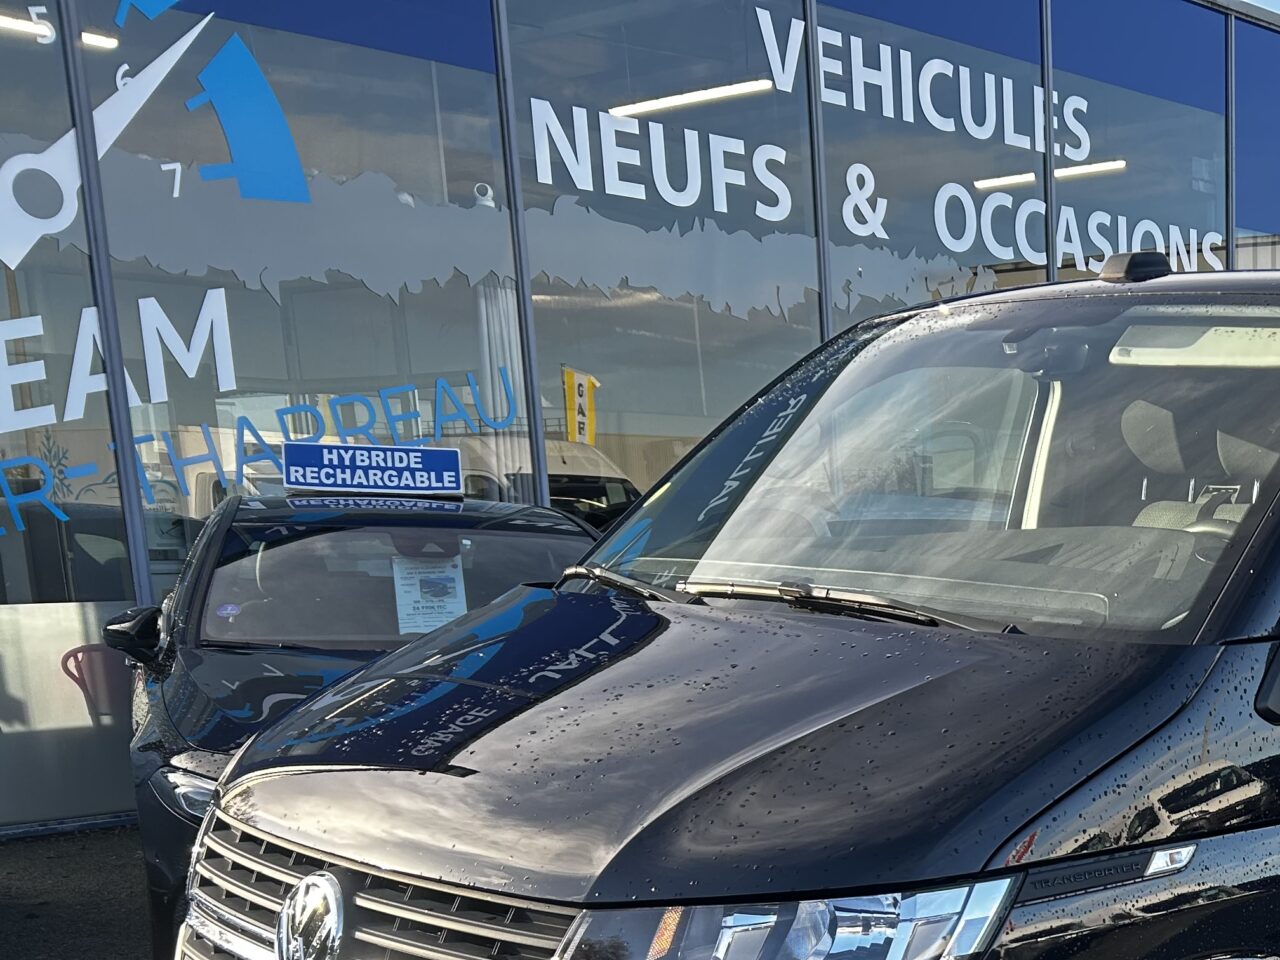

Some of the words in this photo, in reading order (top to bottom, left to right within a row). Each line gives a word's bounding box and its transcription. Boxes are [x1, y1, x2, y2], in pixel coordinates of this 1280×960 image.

[27, 5, 56, 44] 5
[755, 6, 1091, 162] VEHICULES
[160, 162, 182, 198] 7
[530, 97, 792, 222] NEUFS
[842, 163, 890, 239] &
[934, 182, 1224, 273] OCCASIONS
[322, 448, 423, 469] HYBRIDE
[289, 466, 457, 488] RECHARGABLE
[1029, 862, 1143, 890] TRANSPORTER
